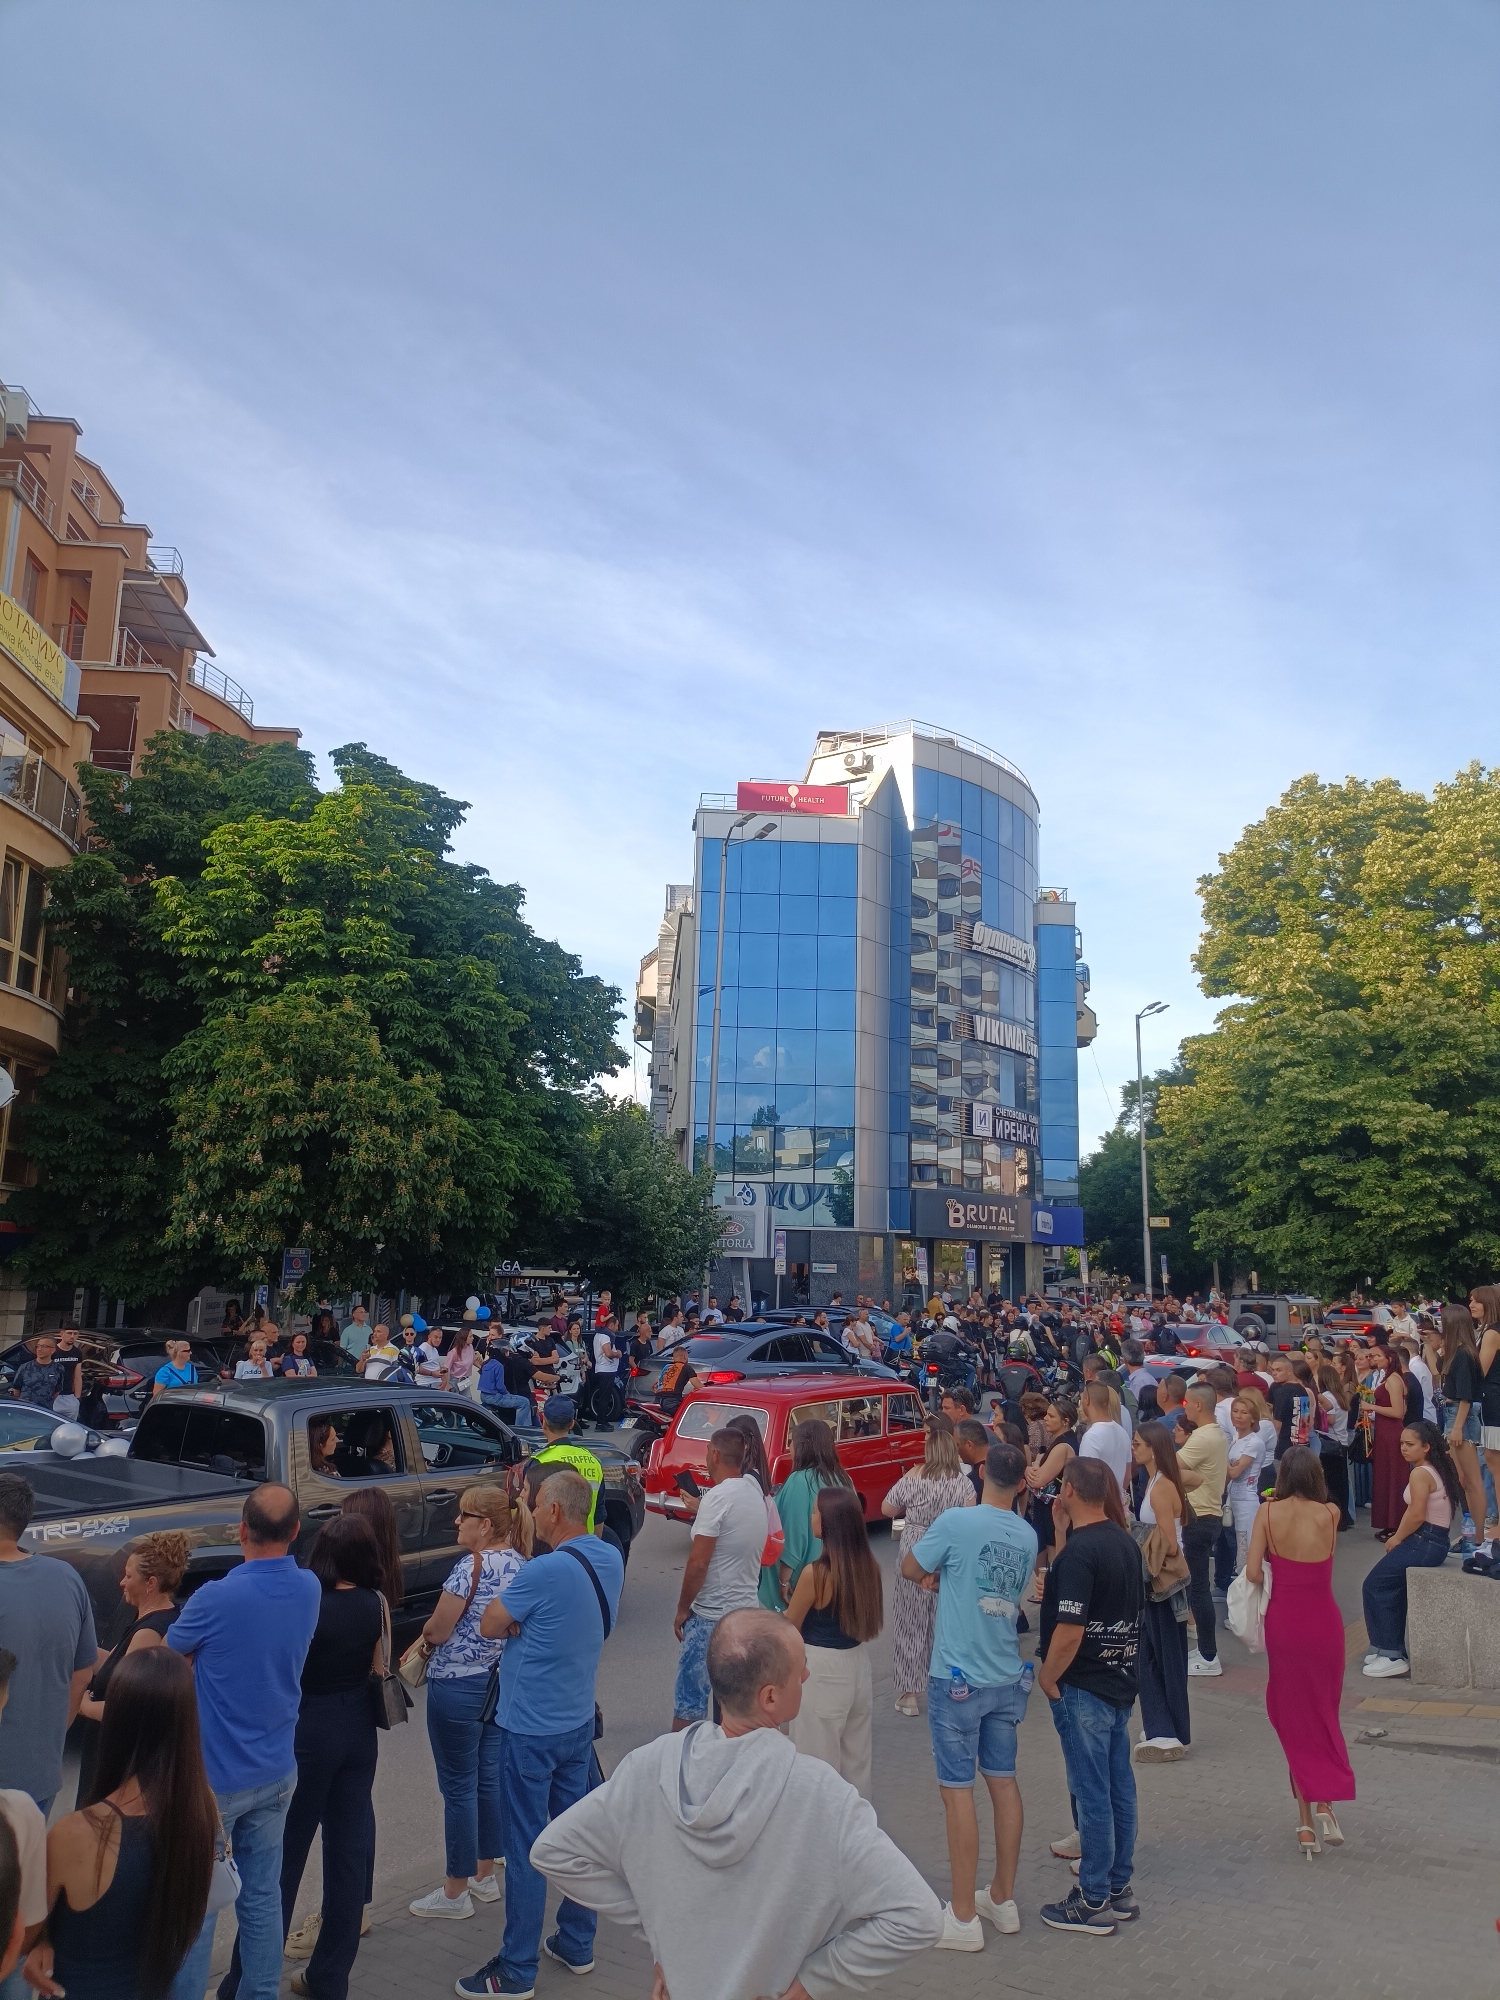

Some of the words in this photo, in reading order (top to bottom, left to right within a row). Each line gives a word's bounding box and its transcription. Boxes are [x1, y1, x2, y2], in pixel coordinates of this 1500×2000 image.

[0, 594, 63, 674] ОТАРИУС
[798, 796, 825, 804] HEALTH
[995, 1107, 1028, 1122] СЧЕТОВОДНА
[948, 1202, 1016, 1228] BRUTAL
[561, 1455, 595, 1464] TRAFFIC
[579, 1468, 596, 1478] LICE
[24, 1522, 81, 1541] TRD
[81, 1526, 128, 1538] SPORT
[1058, 1605, 1082, 1615] PAUSE
[1085, 1620, 1105, 1633] The
[1098, 1648, 1123, 1658] ART
